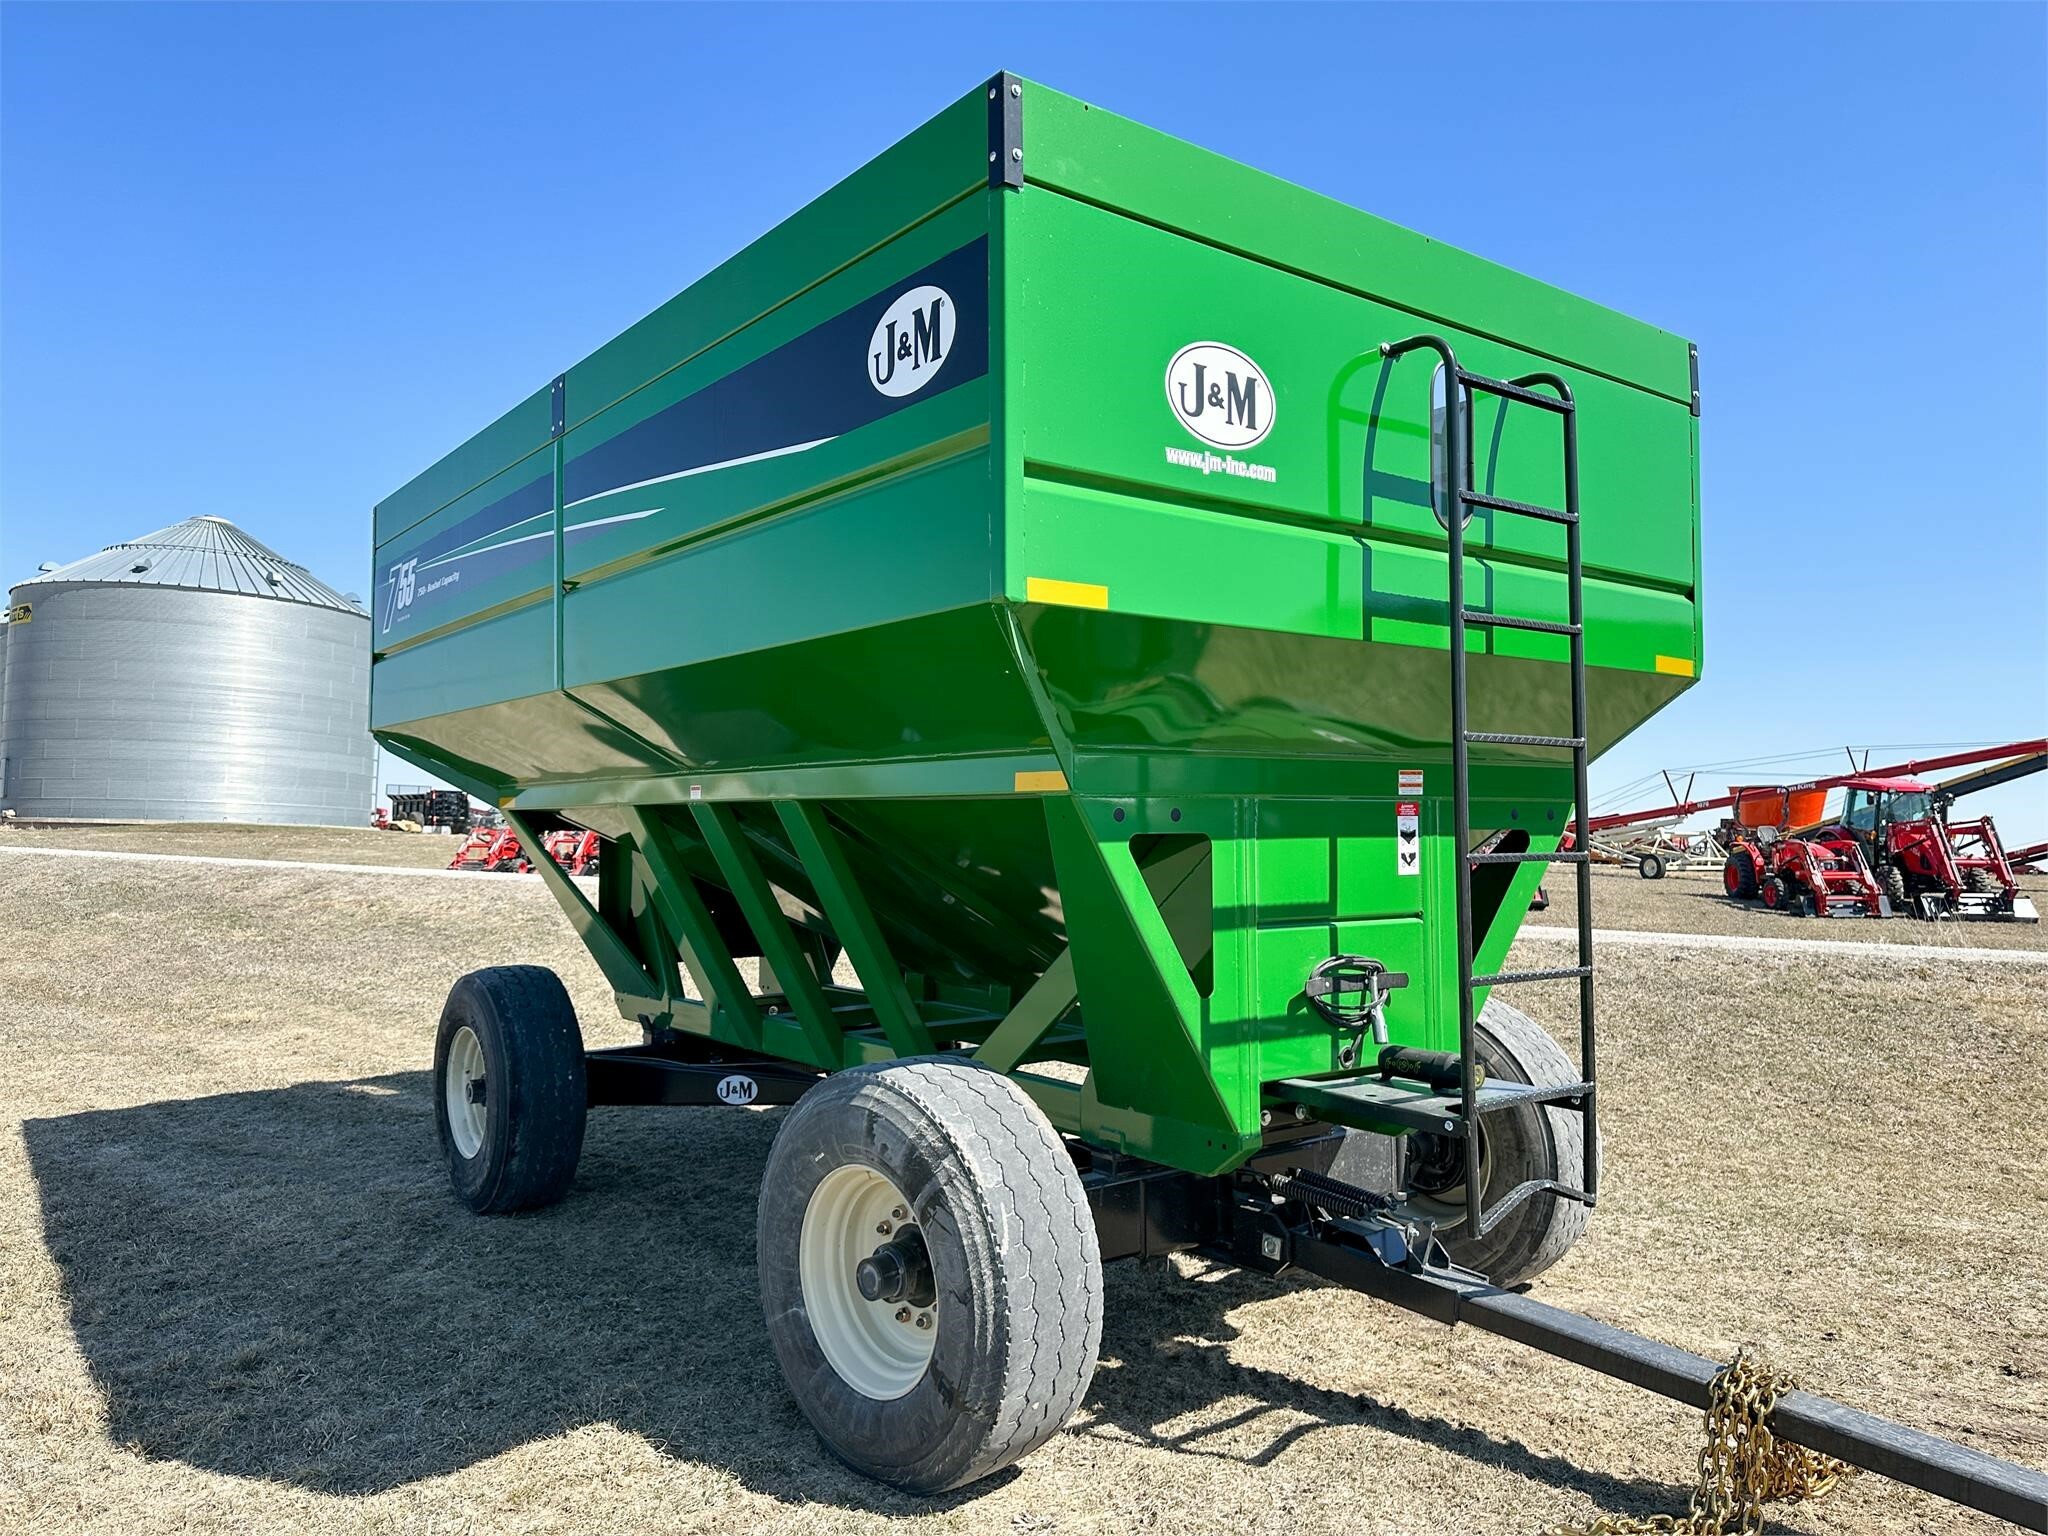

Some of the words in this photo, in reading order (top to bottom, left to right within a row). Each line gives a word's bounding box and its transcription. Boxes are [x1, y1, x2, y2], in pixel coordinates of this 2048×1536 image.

[874, 297, 942, 385] J&M
[1178, 363, 1258, 430] J&M
[1165, 446, 1276, 483] www.jm-inc.com
[383, 558, 417, 634] 755
[441, 572, 460, 586] Capacity
[1776, 786, 1797, 794] Fam
[1797, 782, 1816, 790] King
[719, 1080, 753, 1099] J&M
